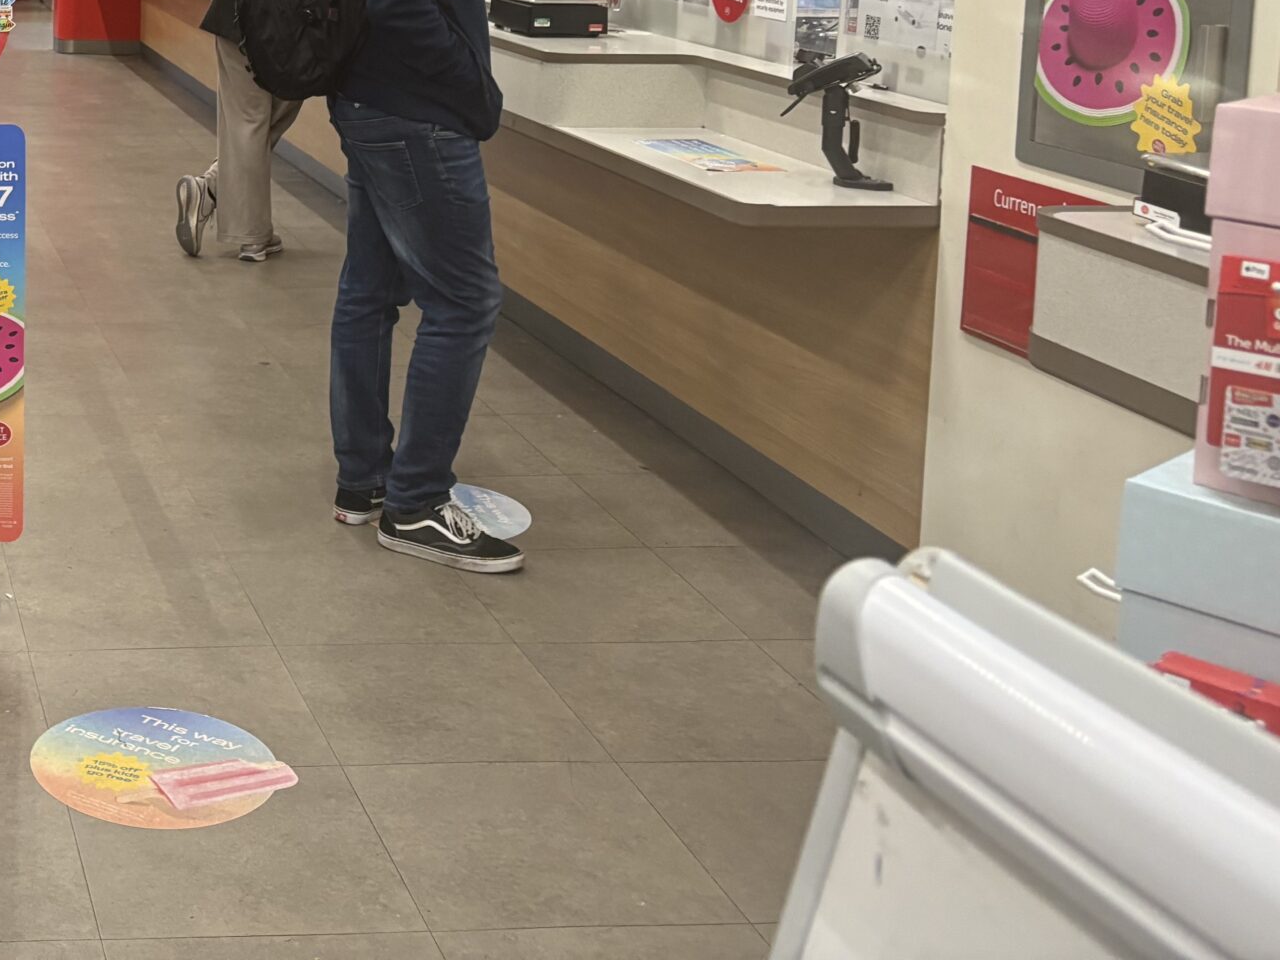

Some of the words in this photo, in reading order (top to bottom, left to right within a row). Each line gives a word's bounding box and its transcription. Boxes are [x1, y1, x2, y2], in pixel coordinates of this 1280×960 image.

[1145, 94, 1166, 108] your
[1167, 105, 1193, 126] travel
[1161, 89, 1183, 107] Grab
[1140, 113, 1160, 131] here
[1161, 127, 1188, 148] today
[1145, 103, 1188, 135] insurance
[993, 187, 1042, 217] Curren
[1225, 333, 1252, 352] The
[1255, 339, 1280, 355] Mul
[65, 724, 181, 765] insurance
[112, 727, 181, 753] travel
[141, 714, 189, 735] This
[193, 732, 243, 750] way
[170, 735, 200, 748] for
[85, 764, 111, 772] plus
[113, 770, 140, 779] kids
[93, 759, 118, 768] 15%
